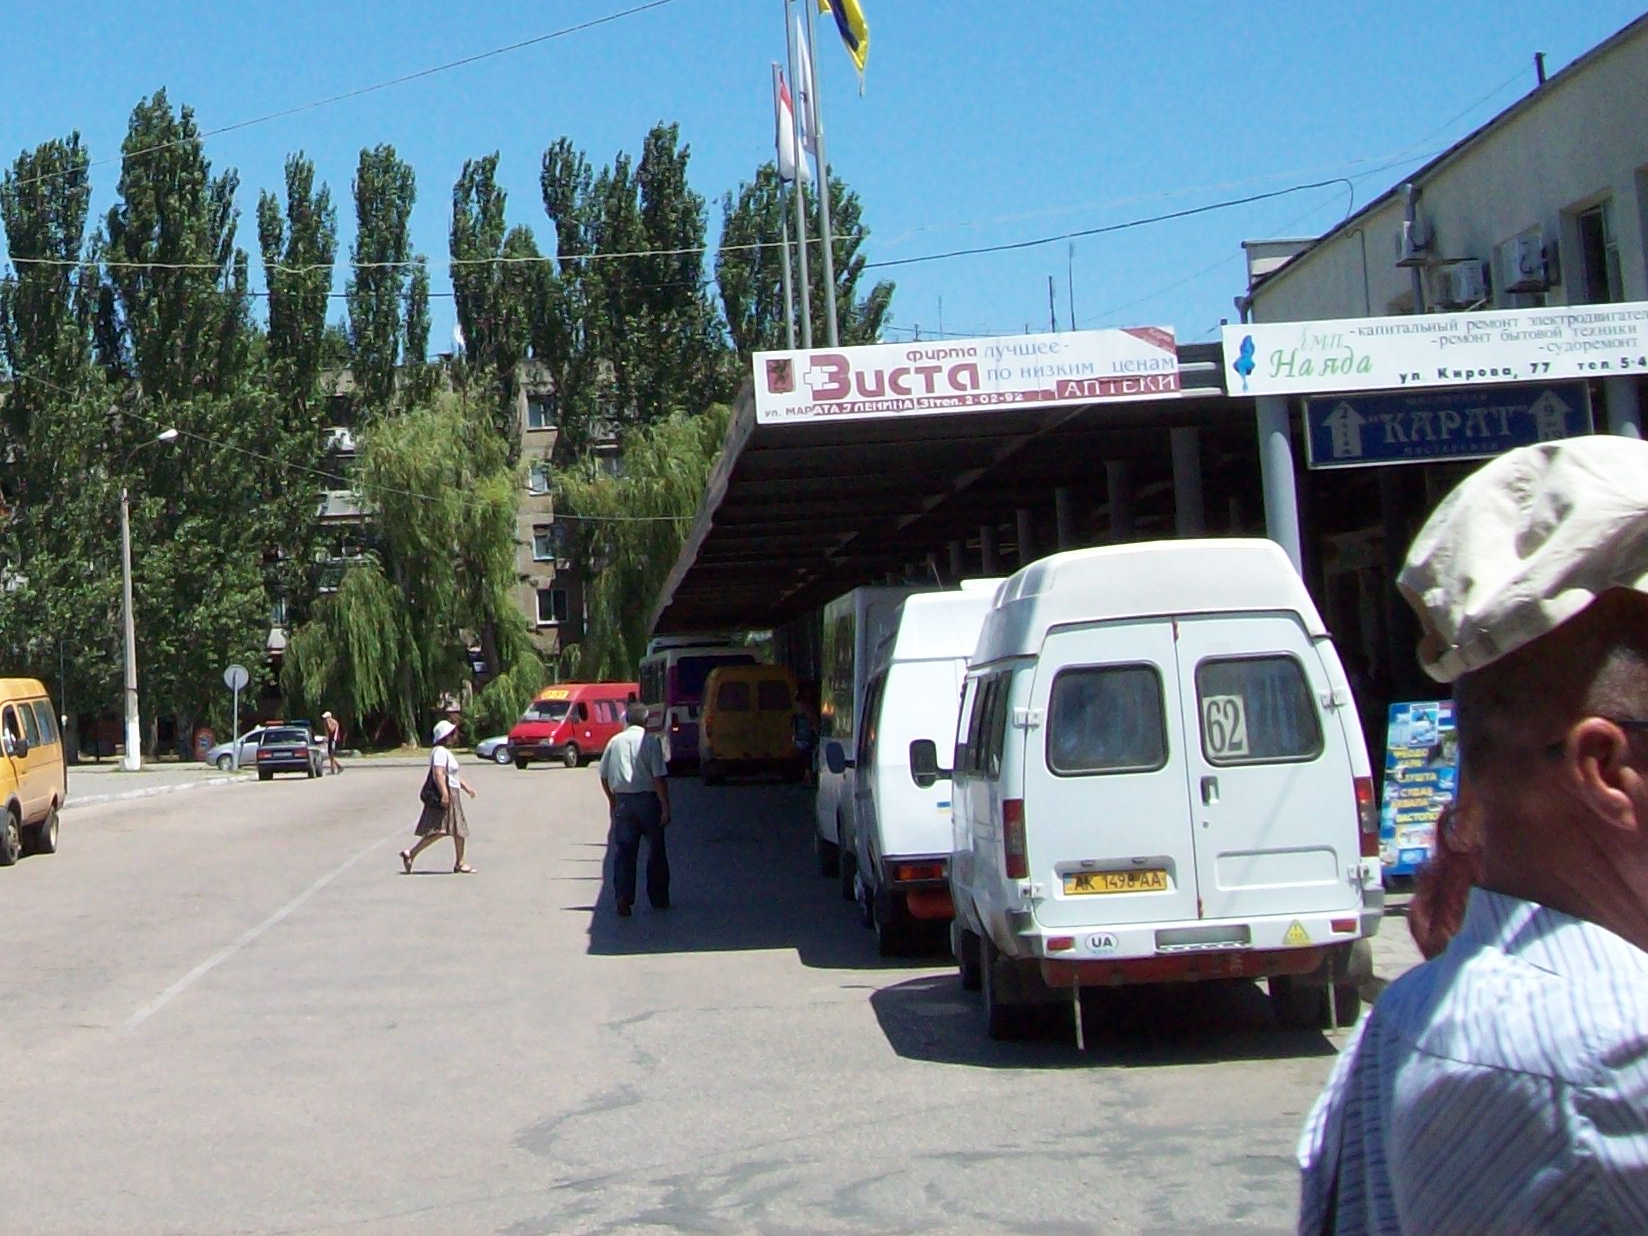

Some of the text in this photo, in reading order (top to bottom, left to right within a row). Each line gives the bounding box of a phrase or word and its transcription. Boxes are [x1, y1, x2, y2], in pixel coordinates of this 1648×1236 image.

[1466, 317, 1519, 334] ремонт
[1501, 327, 1562, 342] бытовой
[1573, 325, 1637, 338] техники
[987, 357, 1175, 381] по низким ценам
[1269, 345, 1373, 378] Наяда
[1530, 362, 1552, 374] 77
[808, 353, 981, 401] Виста
[1064, 375, 1177, 397] АПТЕКИ
[1205, 698, 1242, 753] 62
[1091, 936, 1113, 948] UA
